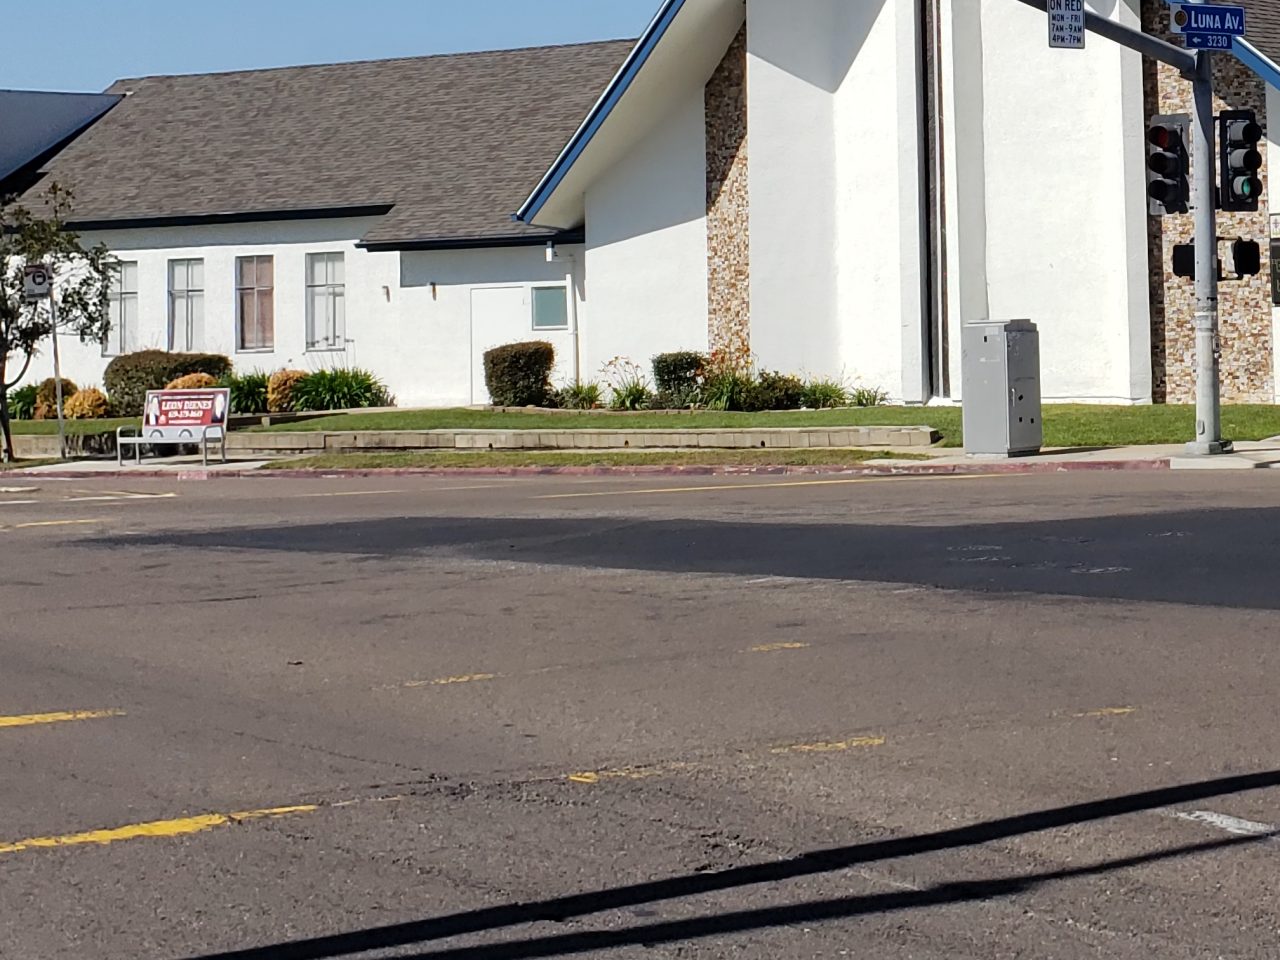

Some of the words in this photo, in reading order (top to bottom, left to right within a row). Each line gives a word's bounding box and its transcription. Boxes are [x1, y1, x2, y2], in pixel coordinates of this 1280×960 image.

[1065, 0, 1082, 11] RED
[1191, 10, 1221, 29] LUNA
[1207, 35, 1228, 47] 3230
